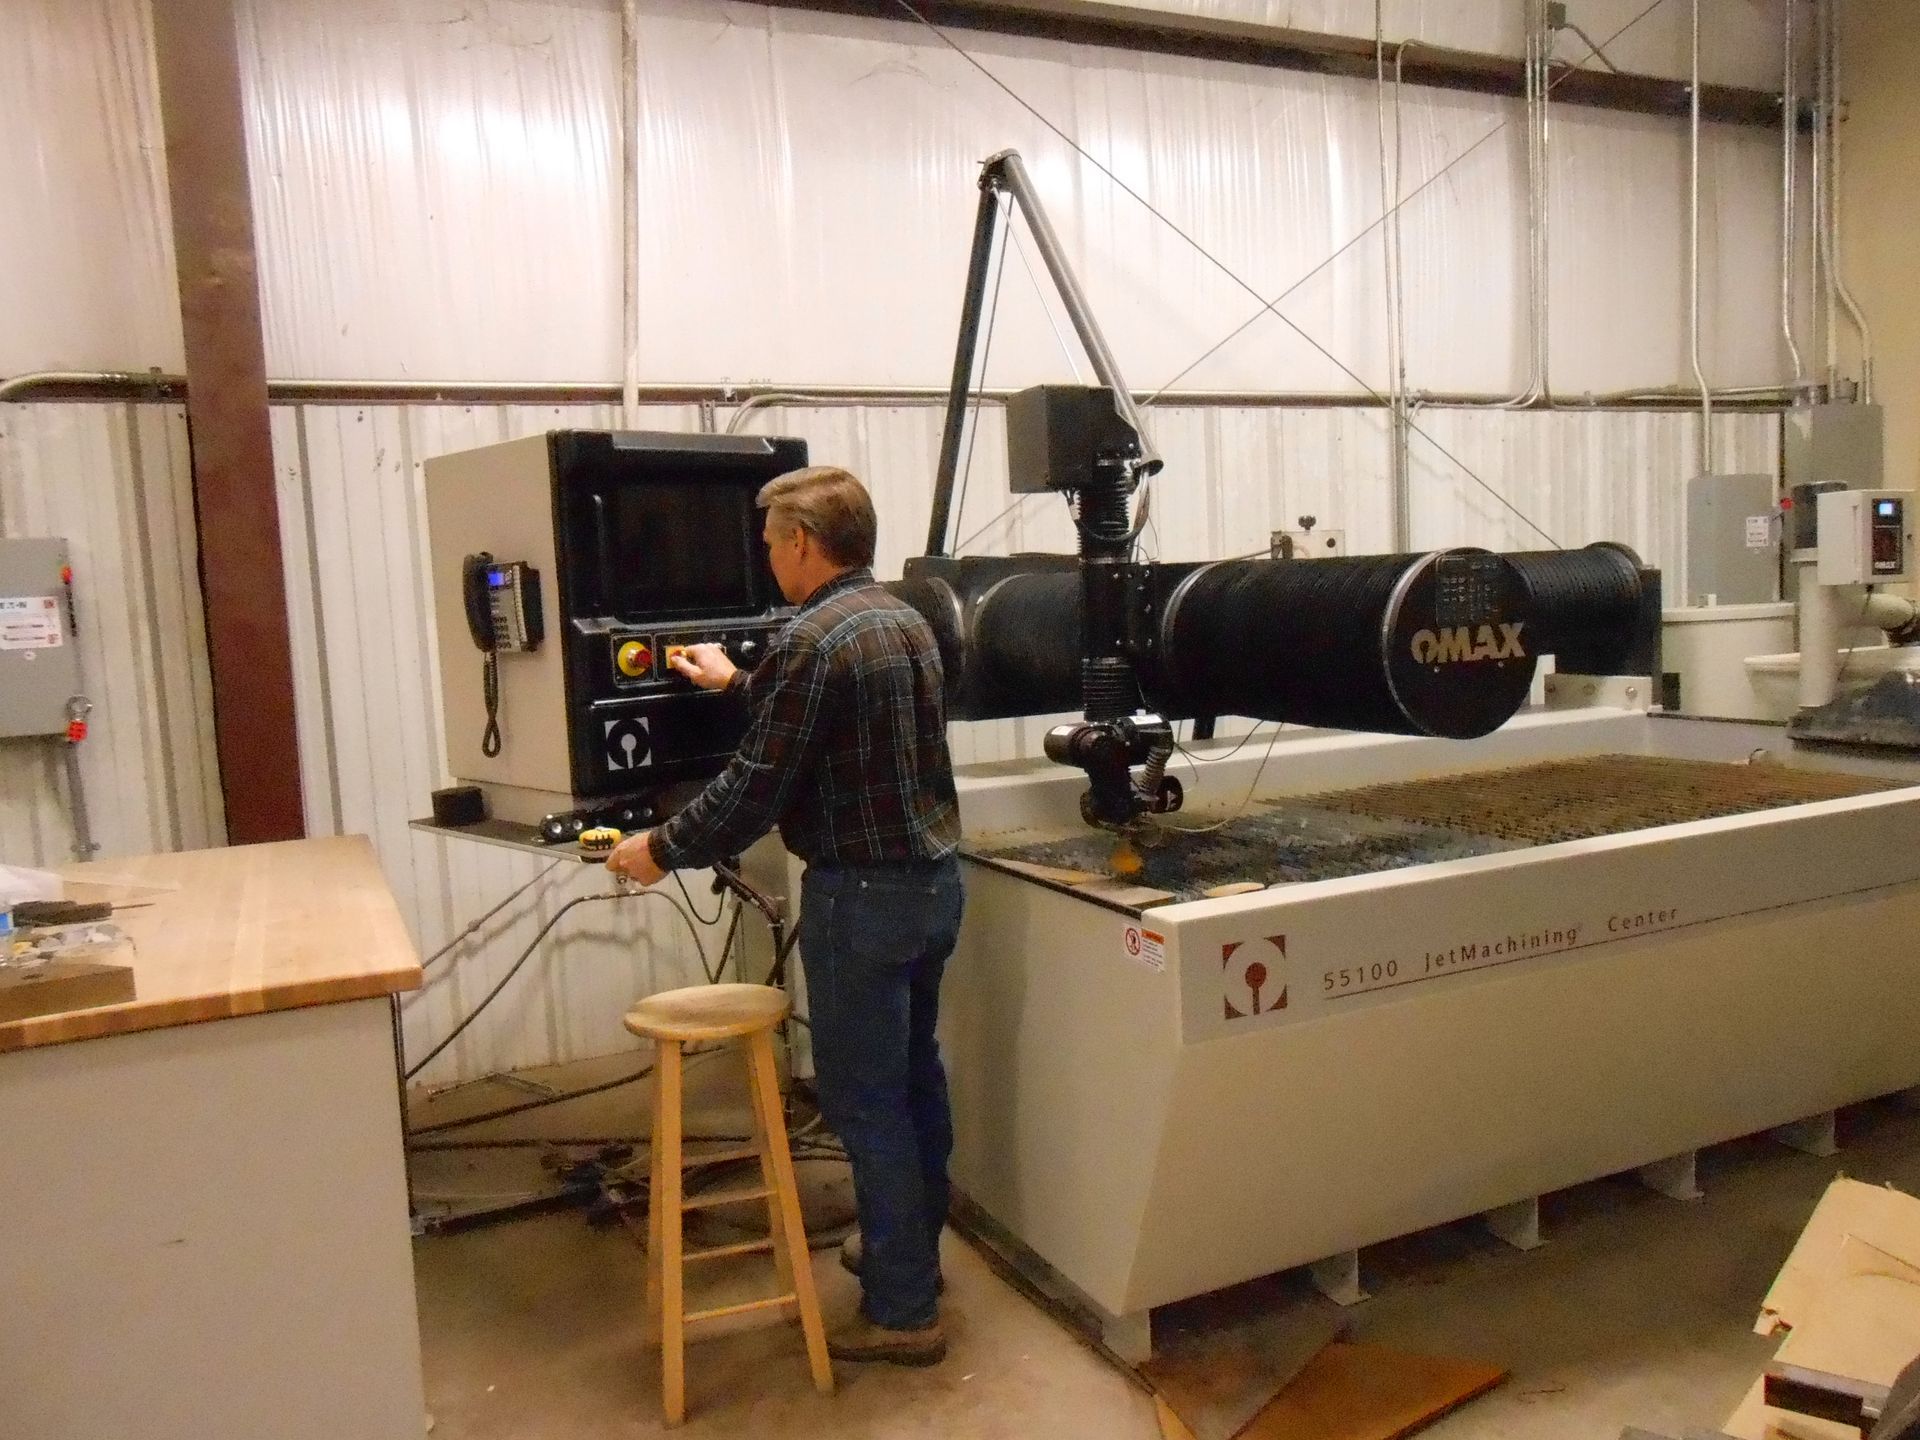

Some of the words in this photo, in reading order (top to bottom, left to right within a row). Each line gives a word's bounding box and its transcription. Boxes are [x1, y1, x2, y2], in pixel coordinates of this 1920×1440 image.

[1411, 621, 1526, 664] OMAX
[1324, 960, 1398, 991] 55100
[1607, 908, 1678, 933] Center
